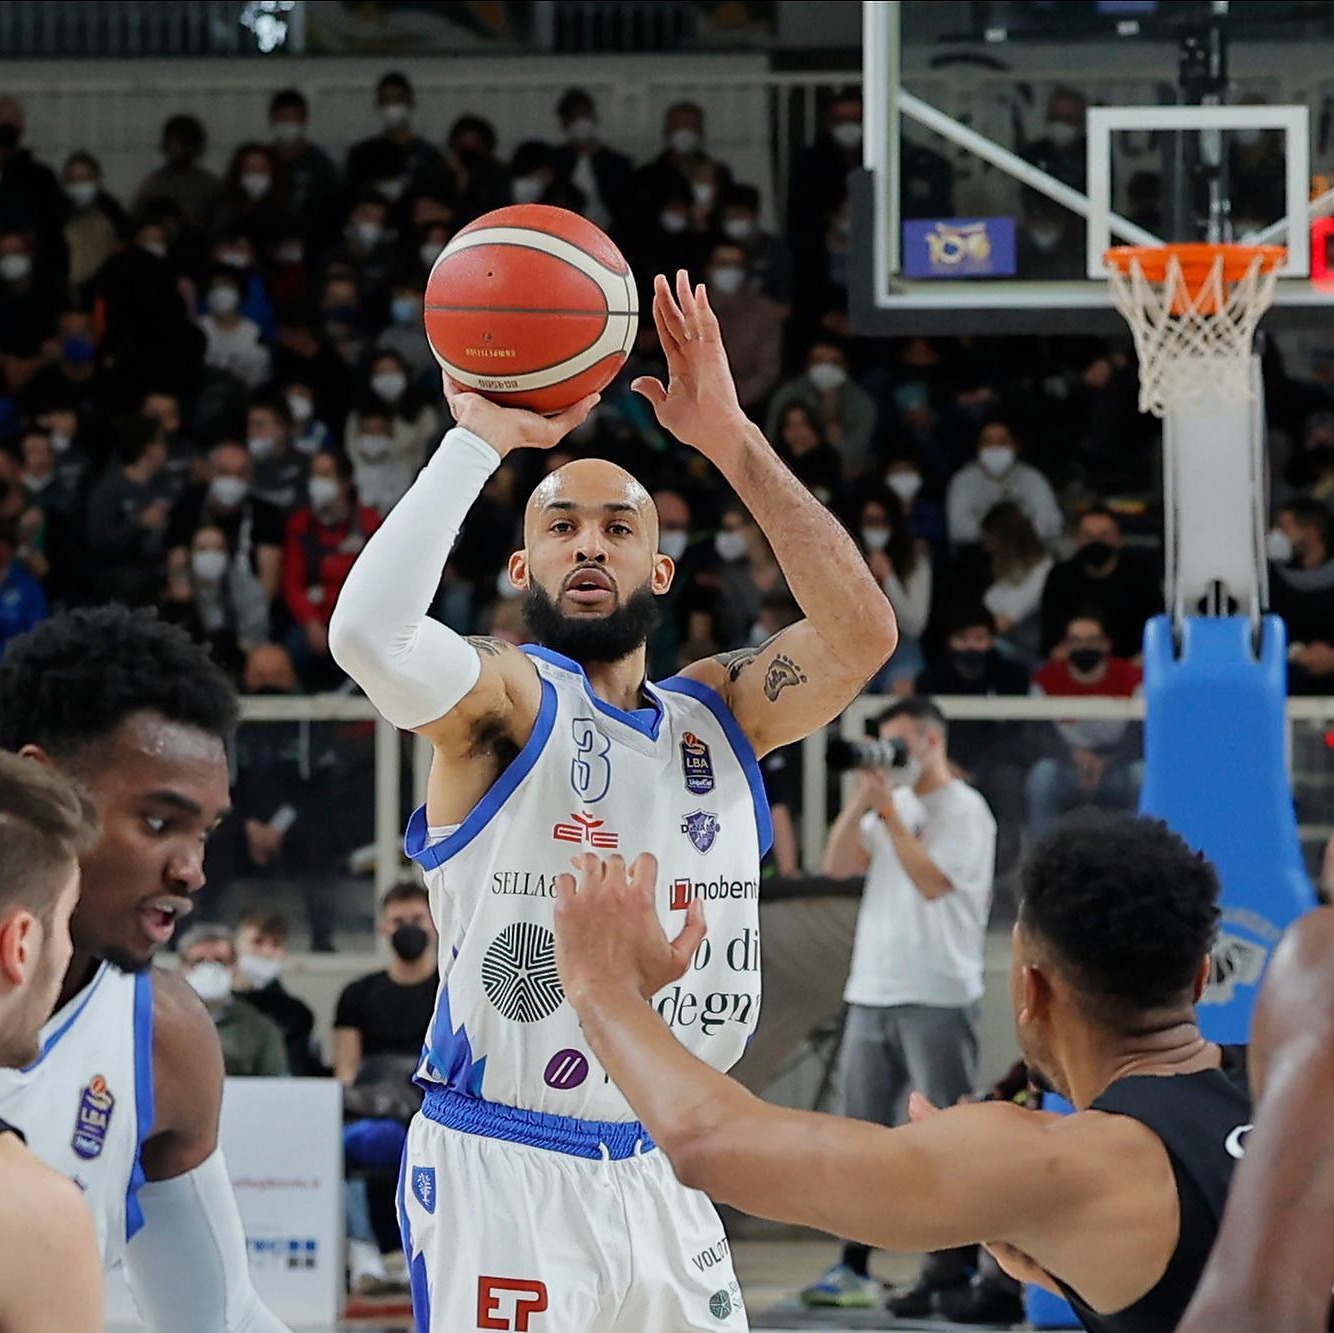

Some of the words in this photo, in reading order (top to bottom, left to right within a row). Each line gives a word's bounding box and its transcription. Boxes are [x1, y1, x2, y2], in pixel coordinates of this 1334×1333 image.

[571, 718, 612, 804] 3
[687, 757, 709, 769] LBA
[726, 928, 759, 972] di
[476, 1275, 549, 1333] EP
